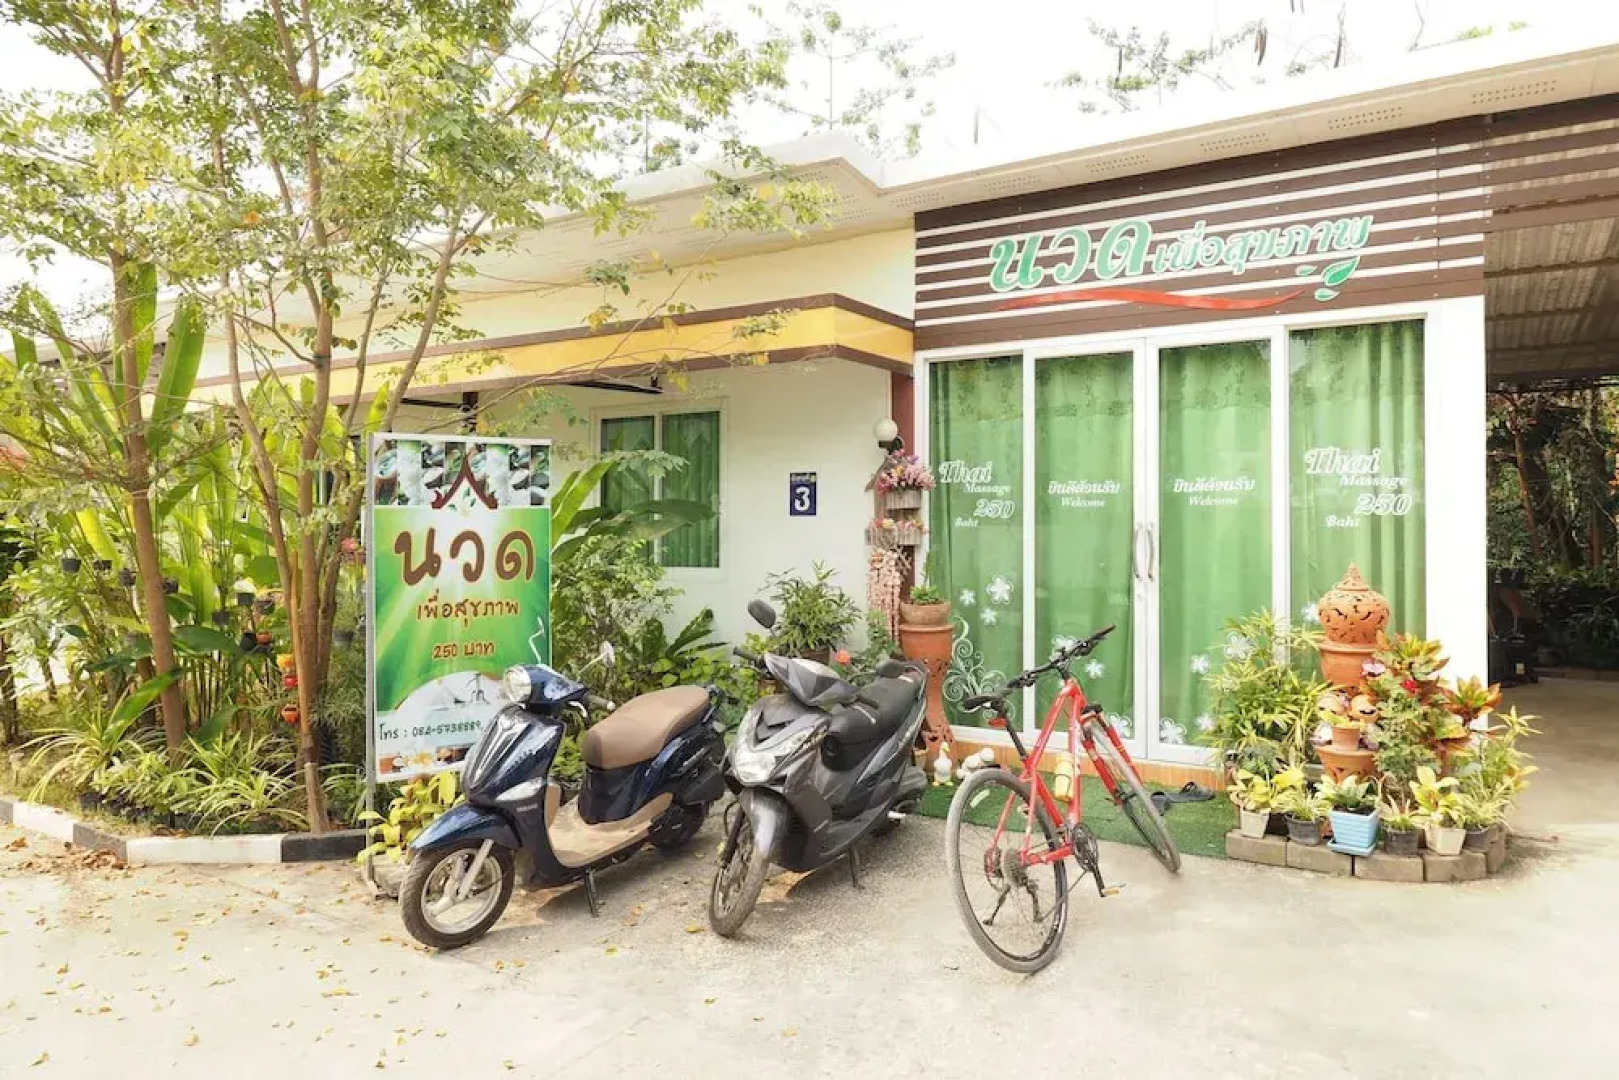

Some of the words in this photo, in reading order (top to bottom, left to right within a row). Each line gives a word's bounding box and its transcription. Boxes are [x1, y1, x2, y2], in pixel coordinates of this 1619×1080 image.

[989, 217, 1153, 292] นวด
[1153, 215, 1373, 275] เพื่อสุขภาพ
[938, 459, 993, 484] Thai
[1303, 446, 1381, 475] Thai
[794, 486, 810, 511] 3
[973, 498, 1015, 519] 250
[1061, 496, 1105, 508] Welcome
[1189, 496, 1239, 507] Welcome
[1353, 493, 1412, 516] 250
[394, 526, 535, 587] นวด
[417, 588, 519, 629] เพื่อสุขภาพ
[433, 644, 459, 660] 250
